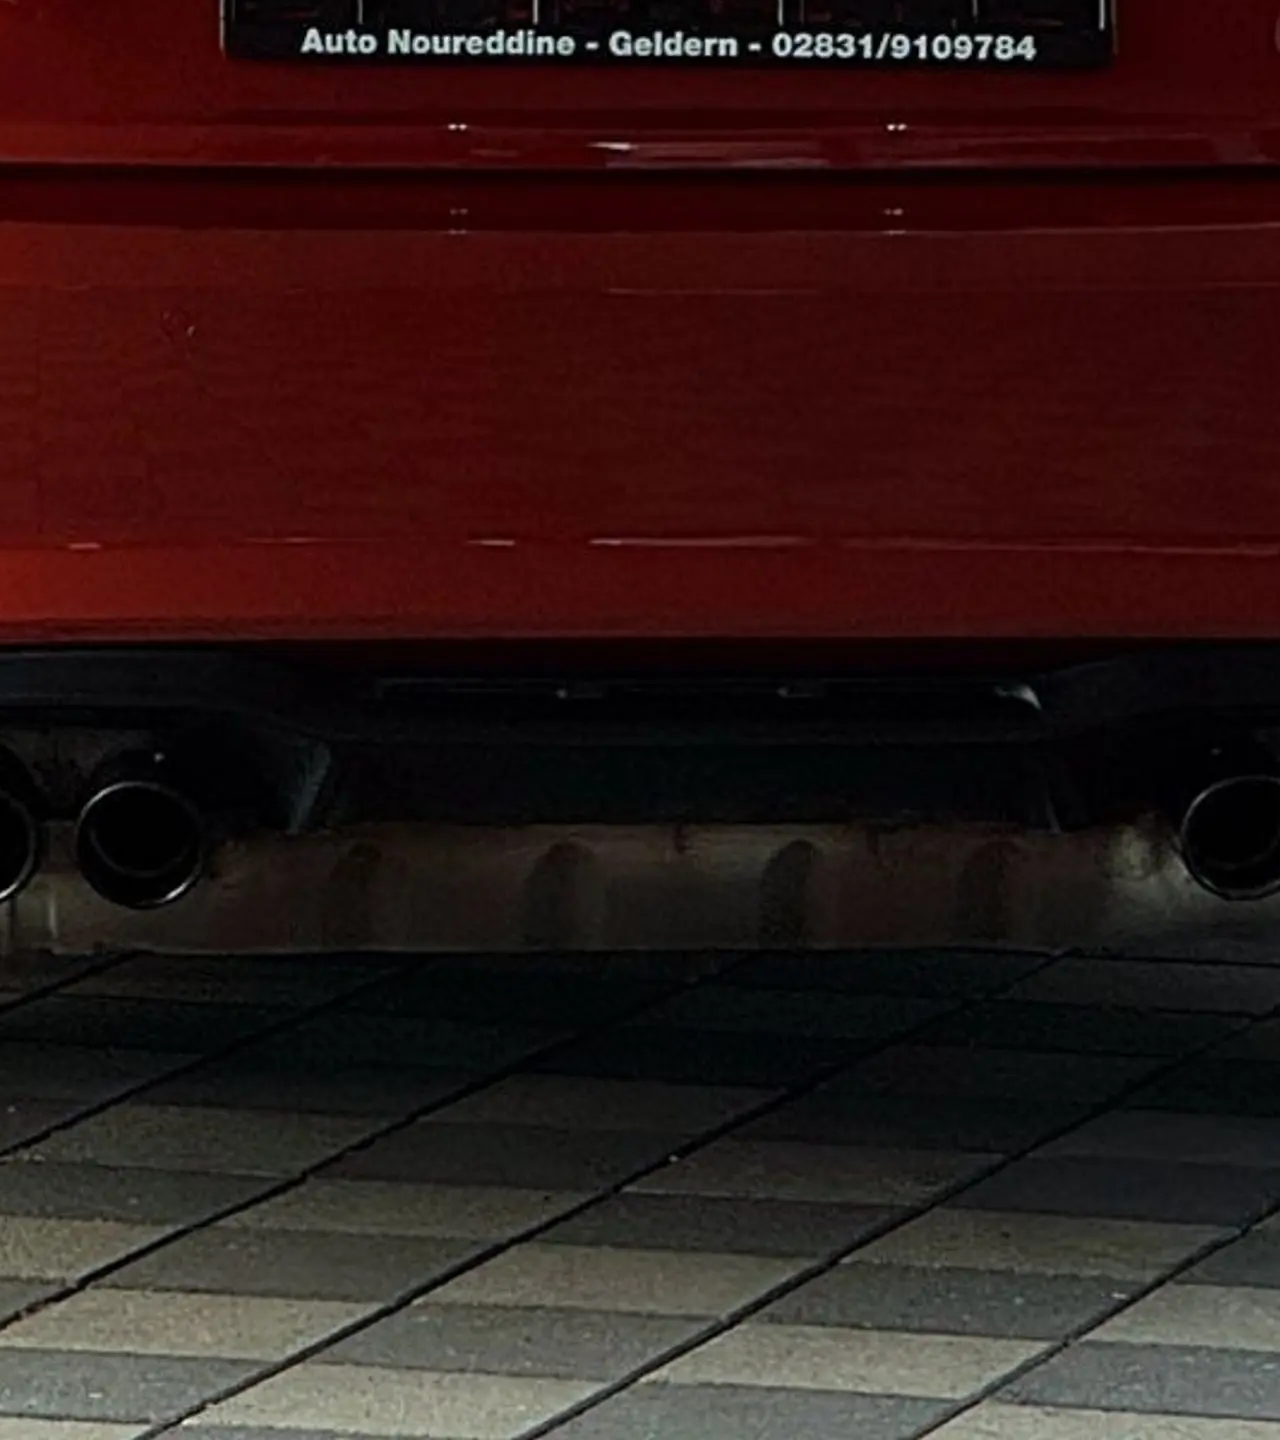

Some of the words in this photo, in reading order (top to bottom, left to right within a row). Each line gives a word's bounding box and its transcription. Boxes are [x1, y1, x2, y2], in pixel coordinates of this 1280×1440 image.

[301, 28, 377, 55] Auto
[387, 29, 575, 57] Noureddine
[608, 30, 738, 57] Geldern
[771, 32, 1037, 60] 02831/9109784
